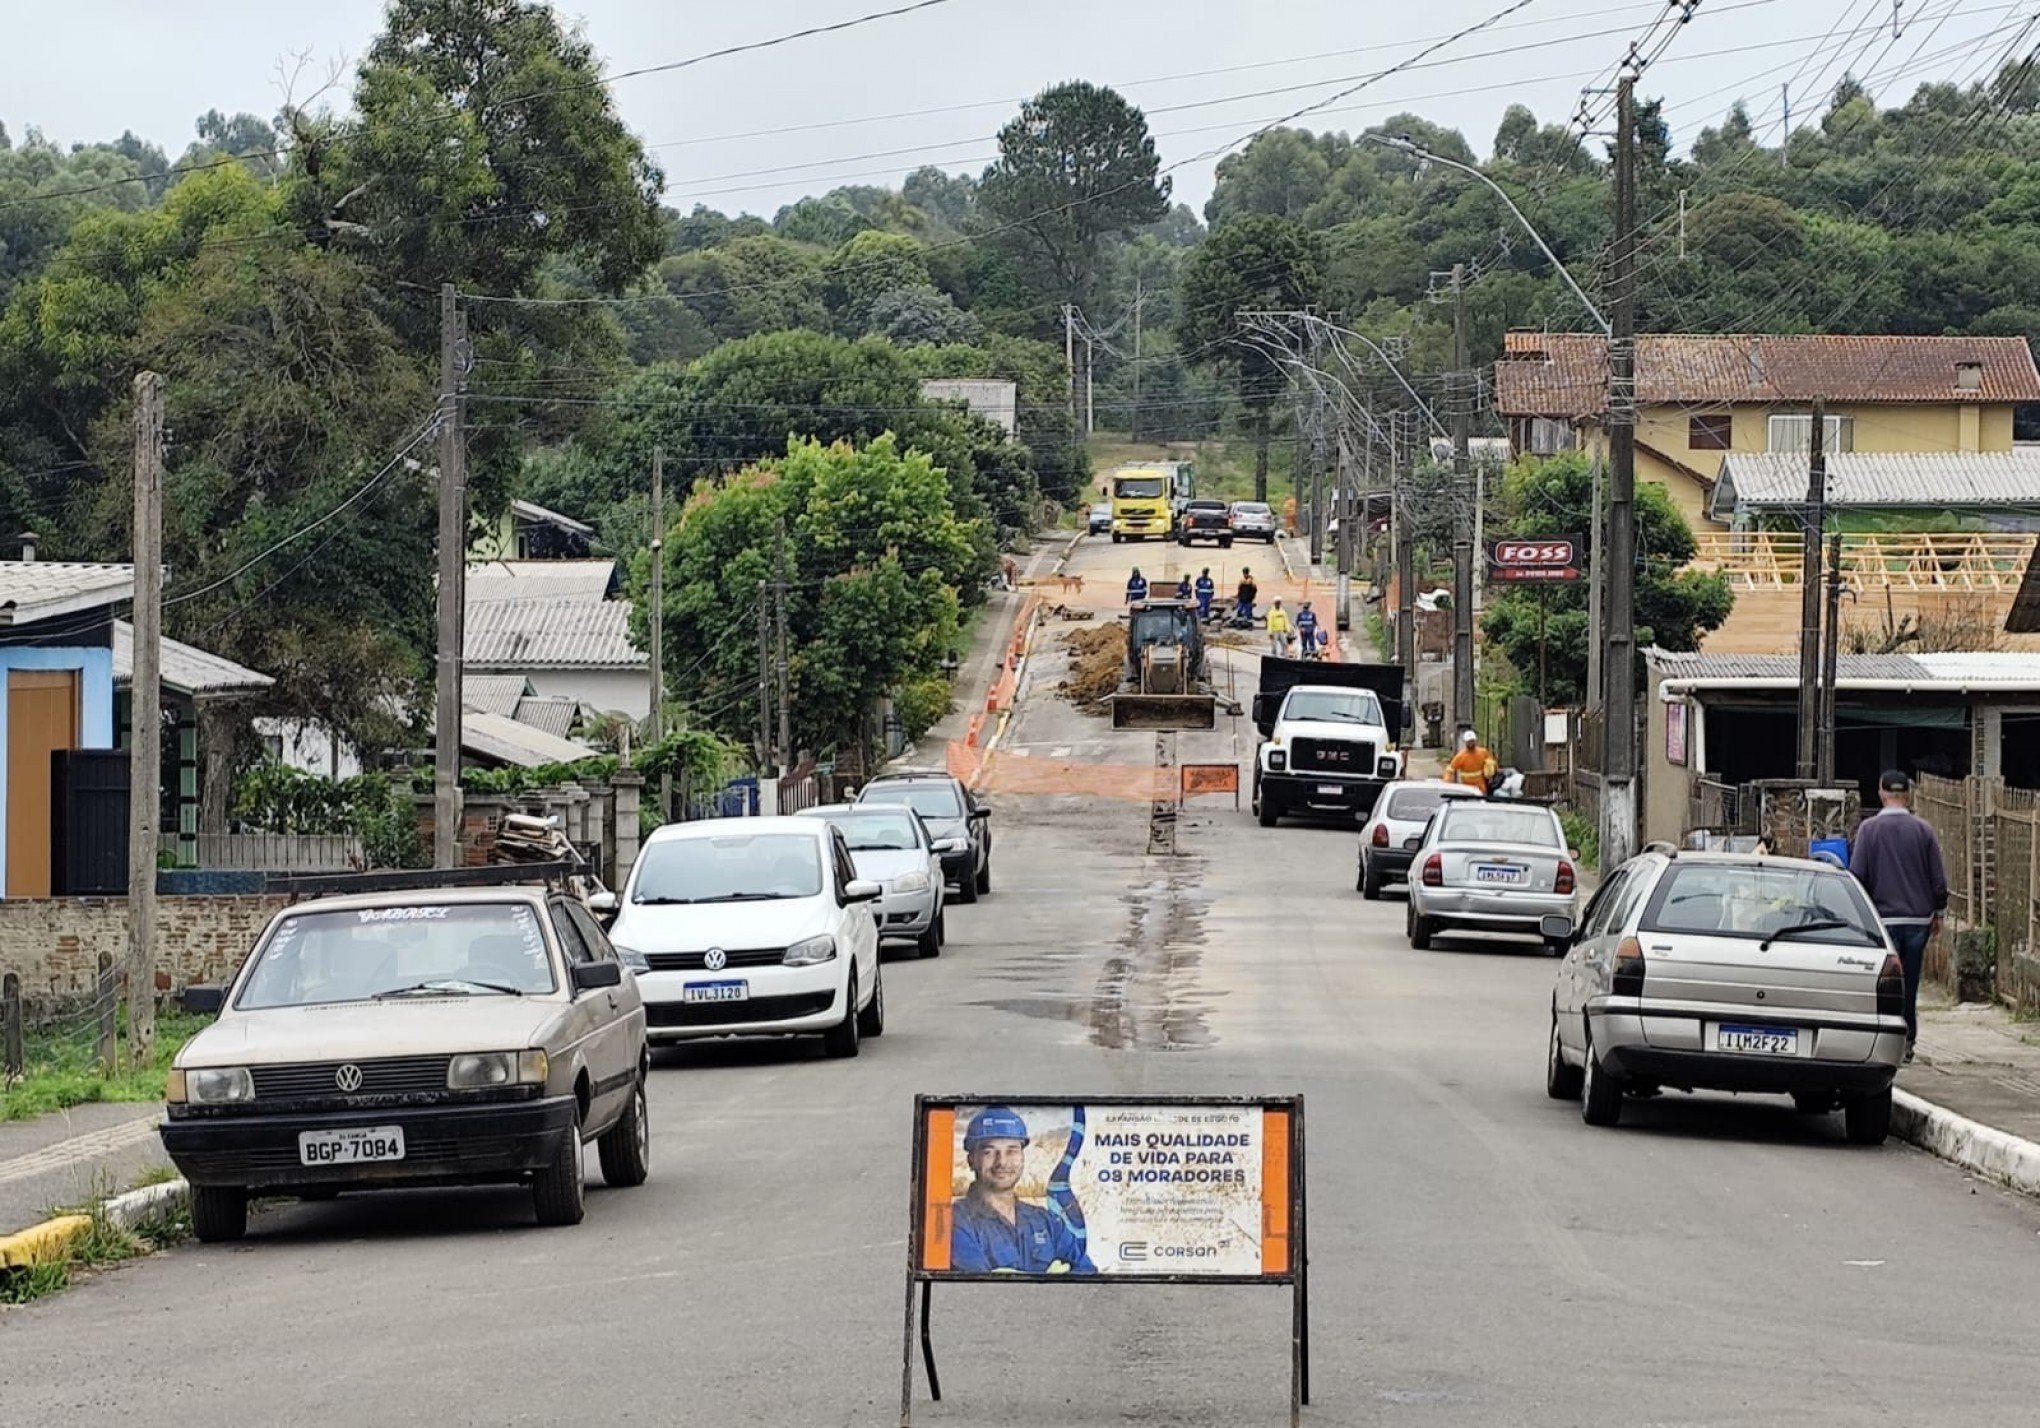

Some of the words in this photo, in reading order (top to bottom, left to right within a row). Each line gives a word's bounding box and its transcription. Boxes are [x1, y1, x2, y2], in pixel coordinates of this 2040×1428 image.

[1503, 547, 1567, 560] FOSS
[1094, 1133, 1141, 1146] MAIS
[1146, 1133, 1250, 1149] QUALIDADE
[1110, 1151, 1132, 1164] DE
[1138, 1151, 1180, 1164] VIDA
[1185, 1152, 1233, 1164] PARA
[1098, 1169, 1122, 1182] OS
[1128, 1169, 1245, 1182] MORADORES
